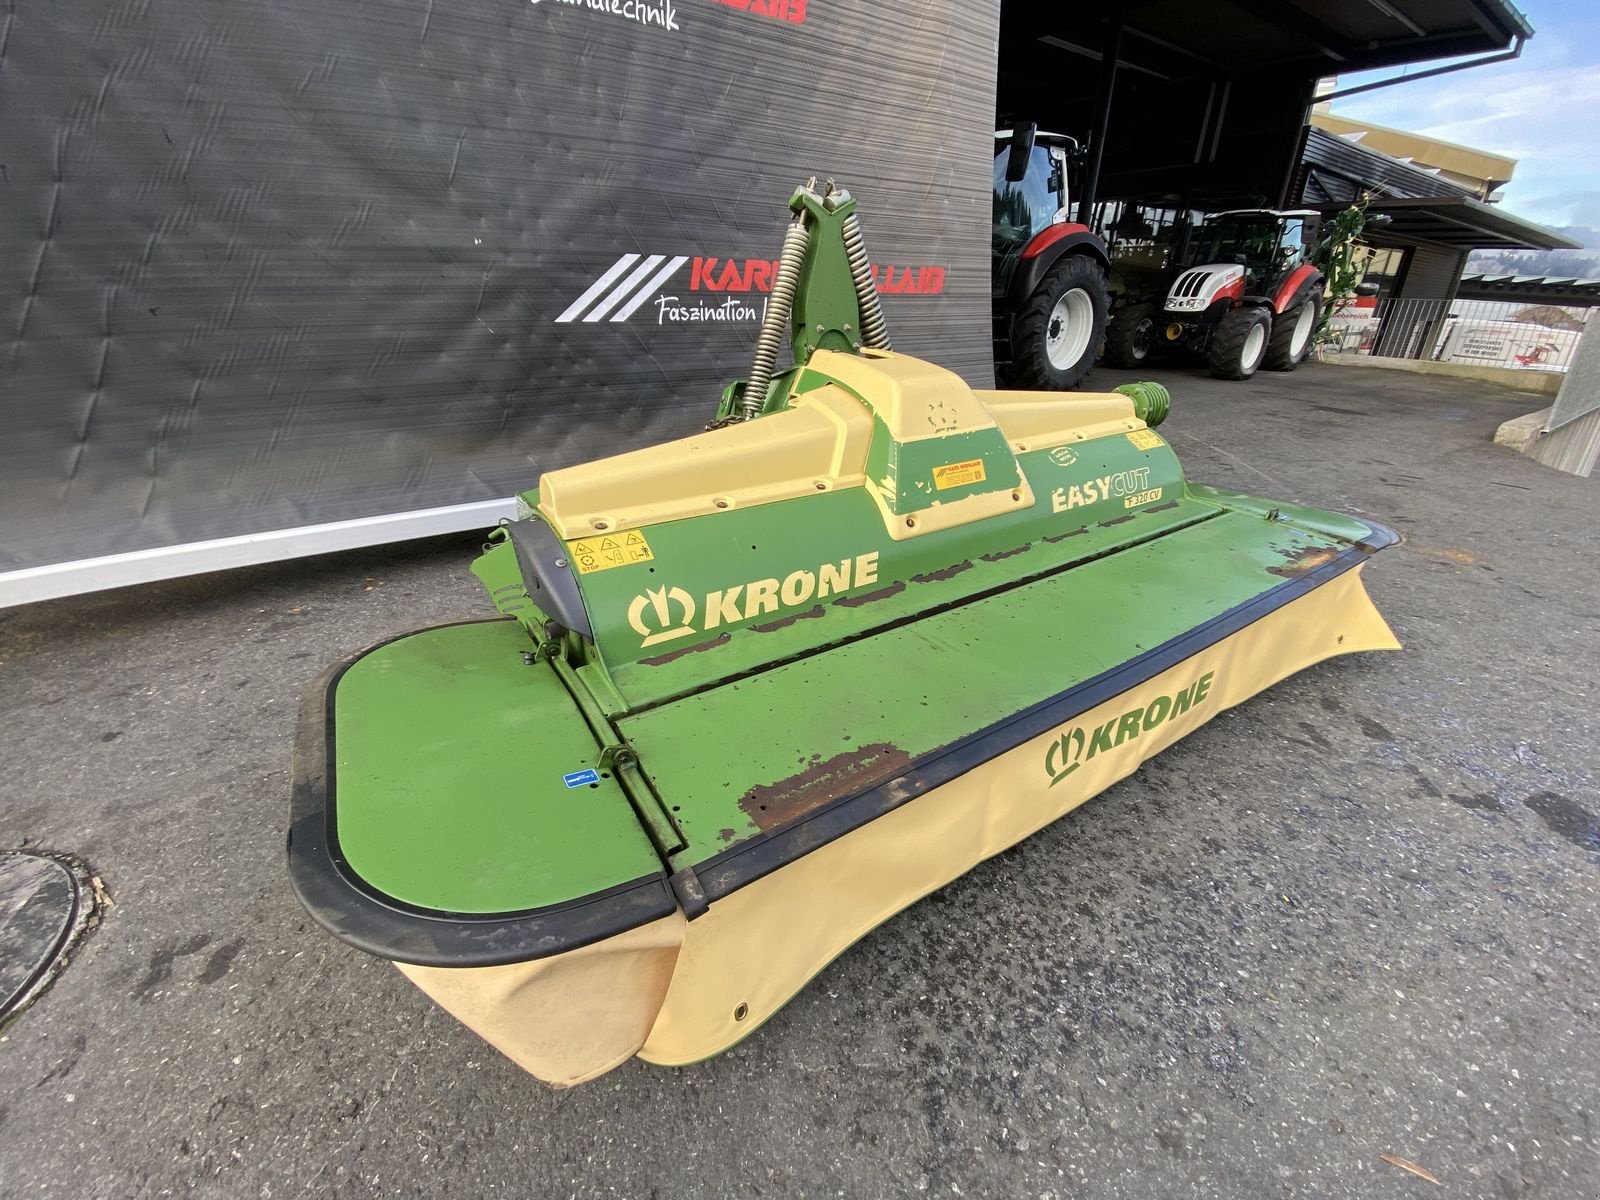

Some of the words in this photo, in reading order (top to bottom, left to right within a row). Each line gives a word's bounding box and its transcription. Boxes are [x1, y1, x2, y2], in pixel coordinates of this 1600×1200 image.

[655, 294, 756, 325] Faszination
[1134, 492, 1148, 506] 320
[1149, 489, 1160, 501] CV
[582, 564, 600, 572] STOP
[704, 551, 880, 630] KRONE
[1085, 670, 1215, 761] KRONE
